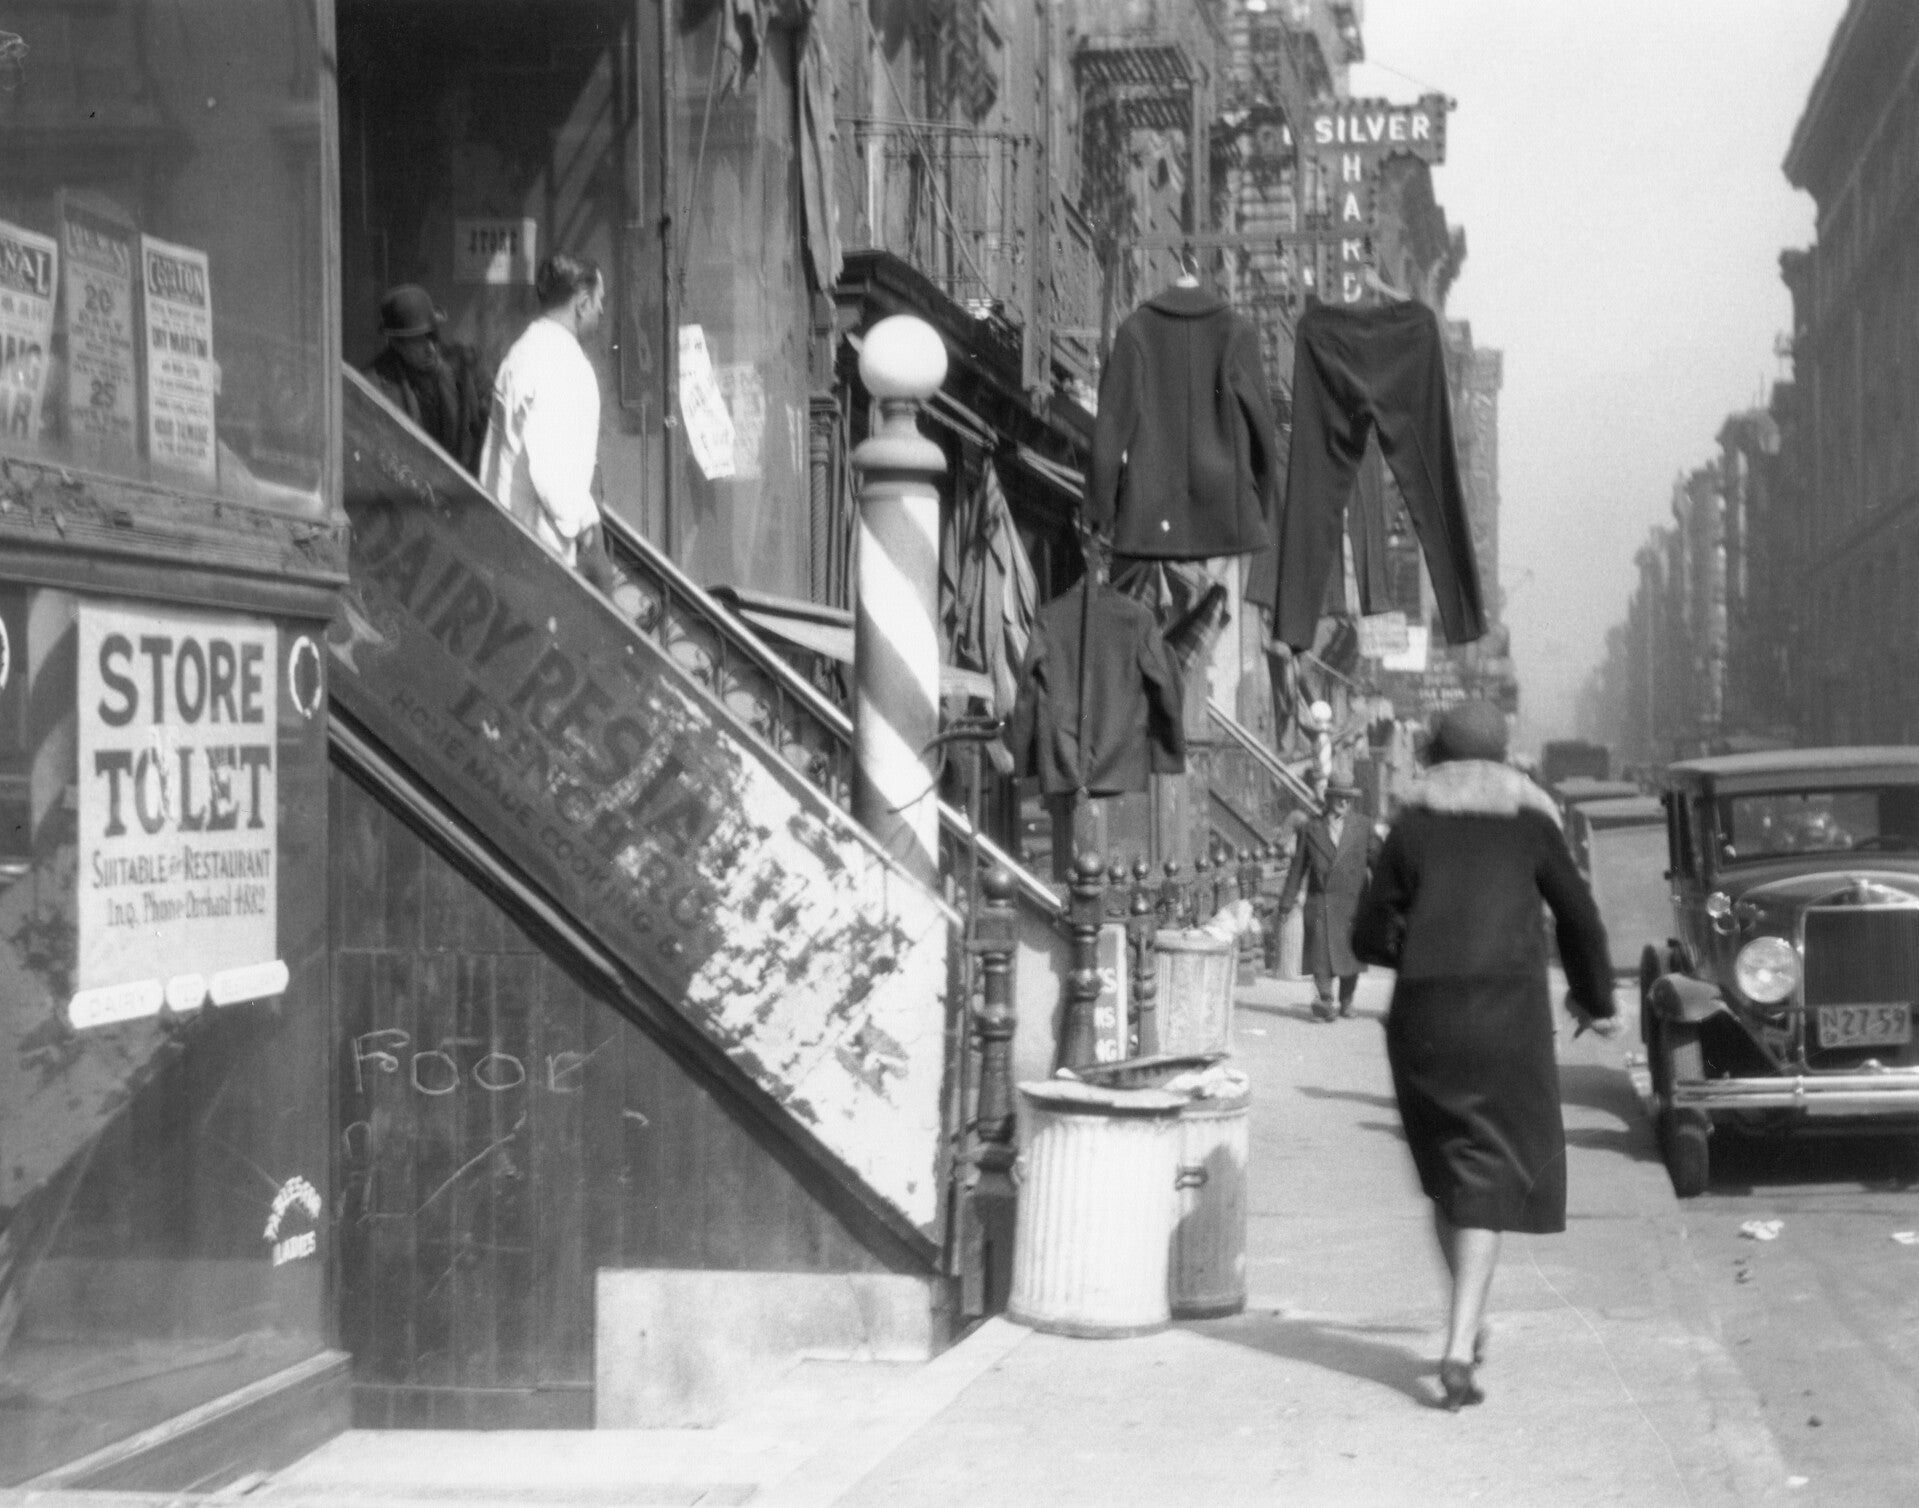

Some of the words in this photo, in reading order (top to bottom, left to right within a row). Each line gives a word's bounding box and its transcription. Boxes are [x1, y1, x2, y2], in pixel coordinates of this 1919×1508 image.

[1314, 113, 1431, 144] SILVER
[98, 632, 265, 727] STORE
[94, 748, 166, 837] TO
[176, 744, 272, 833] LET
[92, 850, 167, 888] SUITABLE
[183, 845, 271, 881] RESTAURANT
